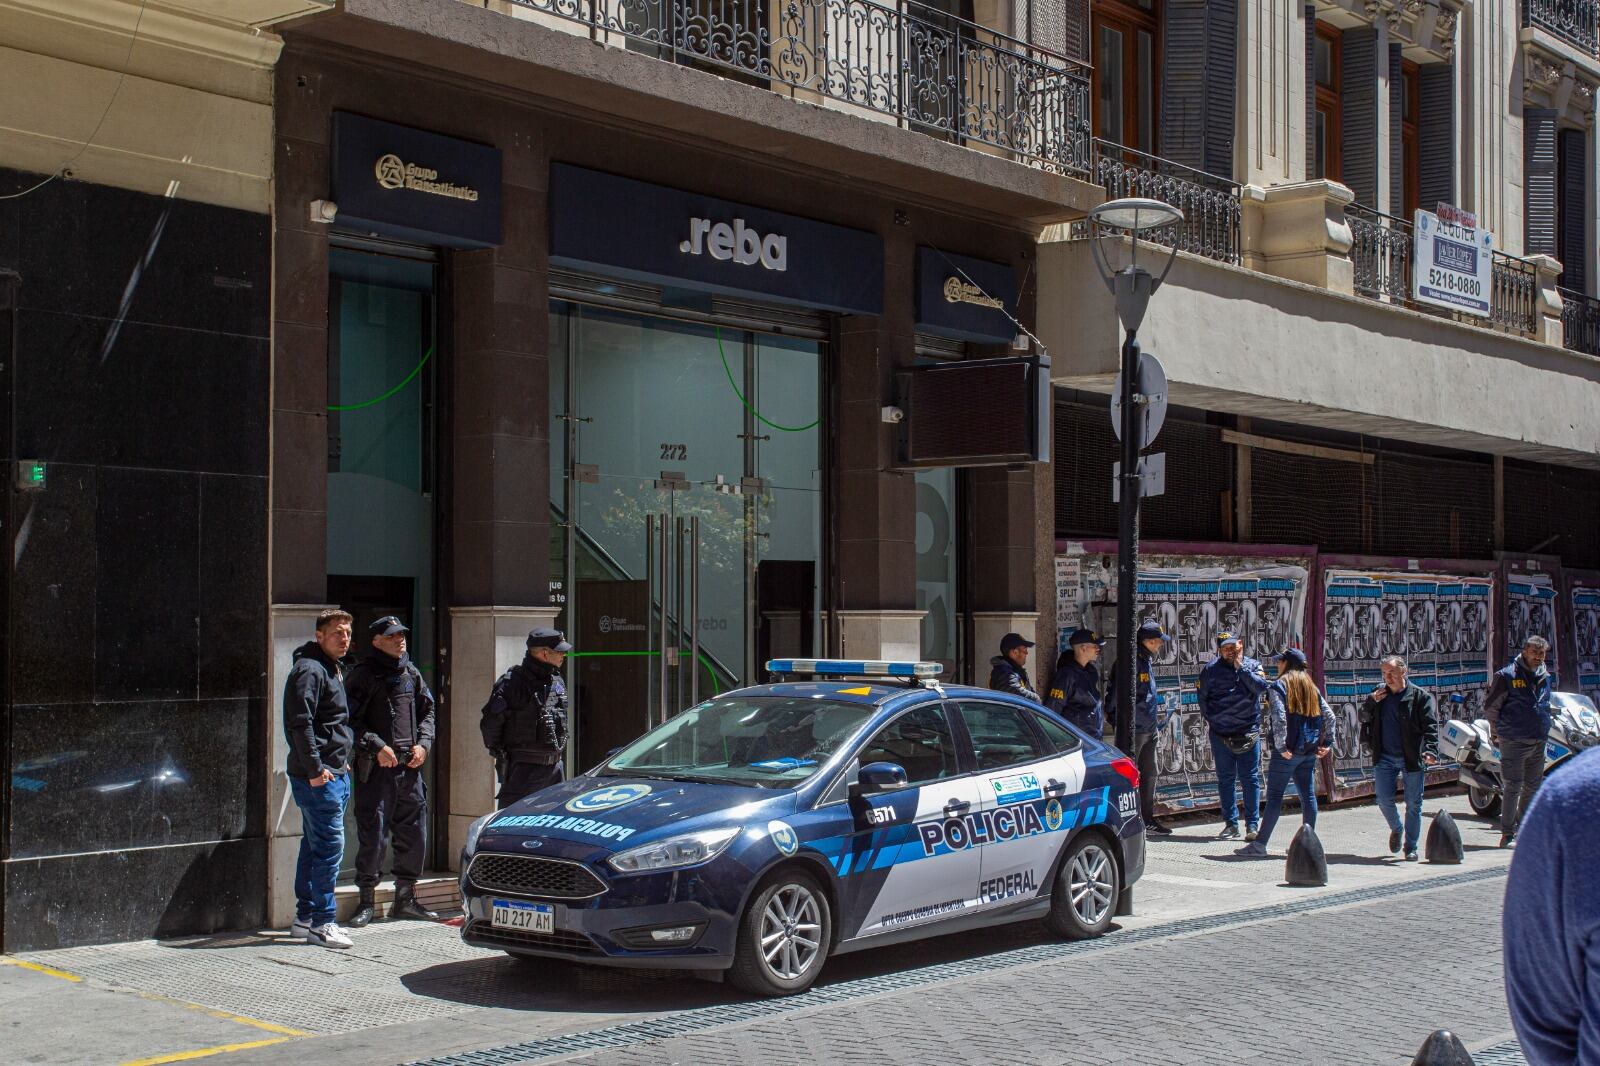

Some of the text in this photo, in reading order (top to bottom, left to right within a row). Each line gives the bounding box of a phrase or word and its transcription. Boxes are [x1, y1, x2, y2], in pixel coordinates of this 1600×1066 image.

[405, 162, 438, 180] Grupo
[1436, 220, 1476, 243] ALQUILA
[1429, 268, 1481, 297] 5218-0880
[660, 443, 687, 460] 272
[1059, 588, 1078, 598] SPLIT
[1512, 679, 1527, 688] PFA
[1050, 688, 1064, 699] PFA
[1447, 727, 1457, 738] PFA
[1019, 775, 1038, 788] 134
[1123, 792, 1137, 810] 911
[917, 803, 1045, 857] POLICIA
[980, 869, 1037, 904] FEDERAL
[494, 908, 550, 931] AD 217 AM
